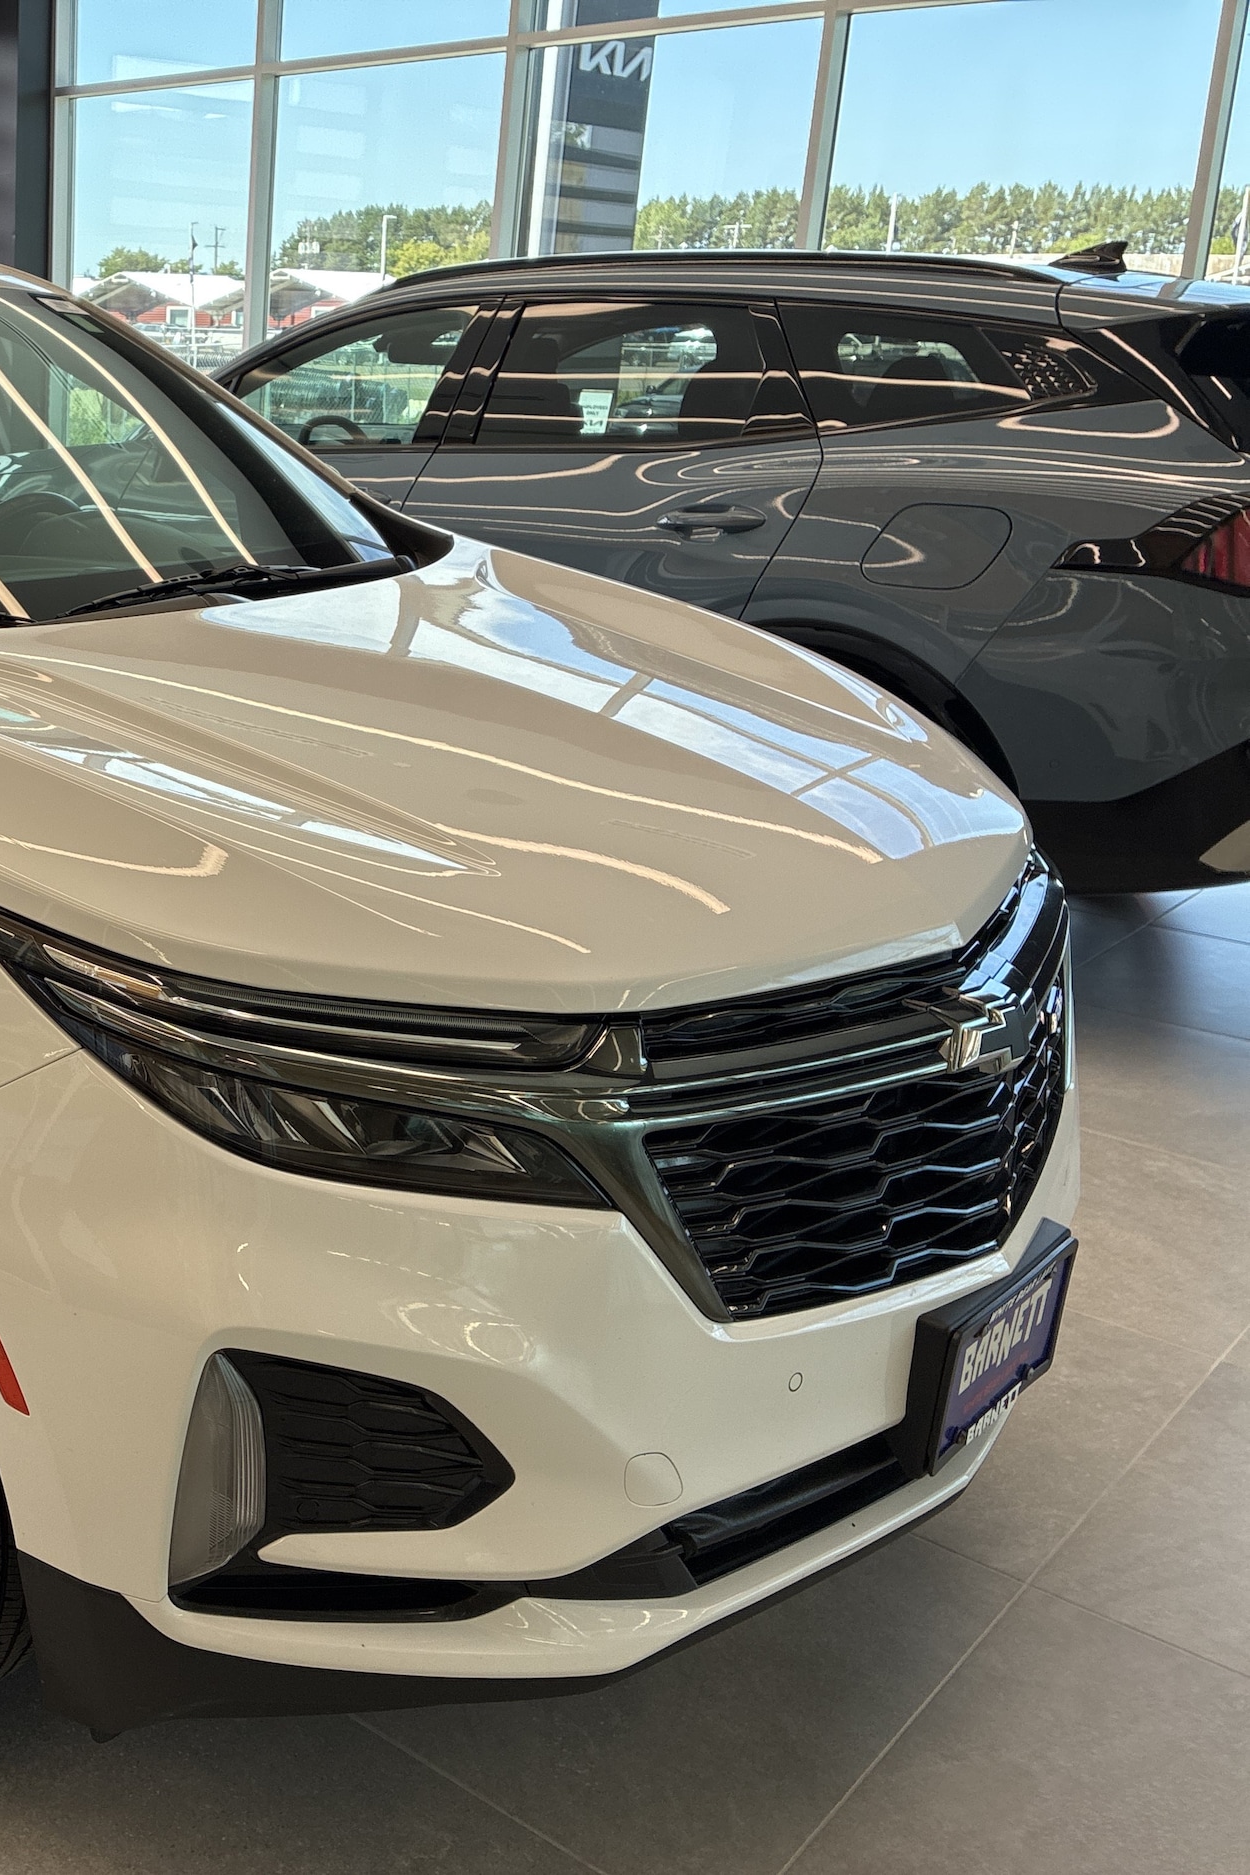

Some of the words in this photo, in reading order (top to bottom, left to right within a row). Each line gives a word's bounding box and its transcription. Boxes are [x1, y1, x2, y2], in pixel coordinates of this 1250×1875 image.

[579, 41, 653, 81] KIA
[958, 1278, 1053, 1396] BARNETT
[966, 1381, 1023, 1446] BARNETT
